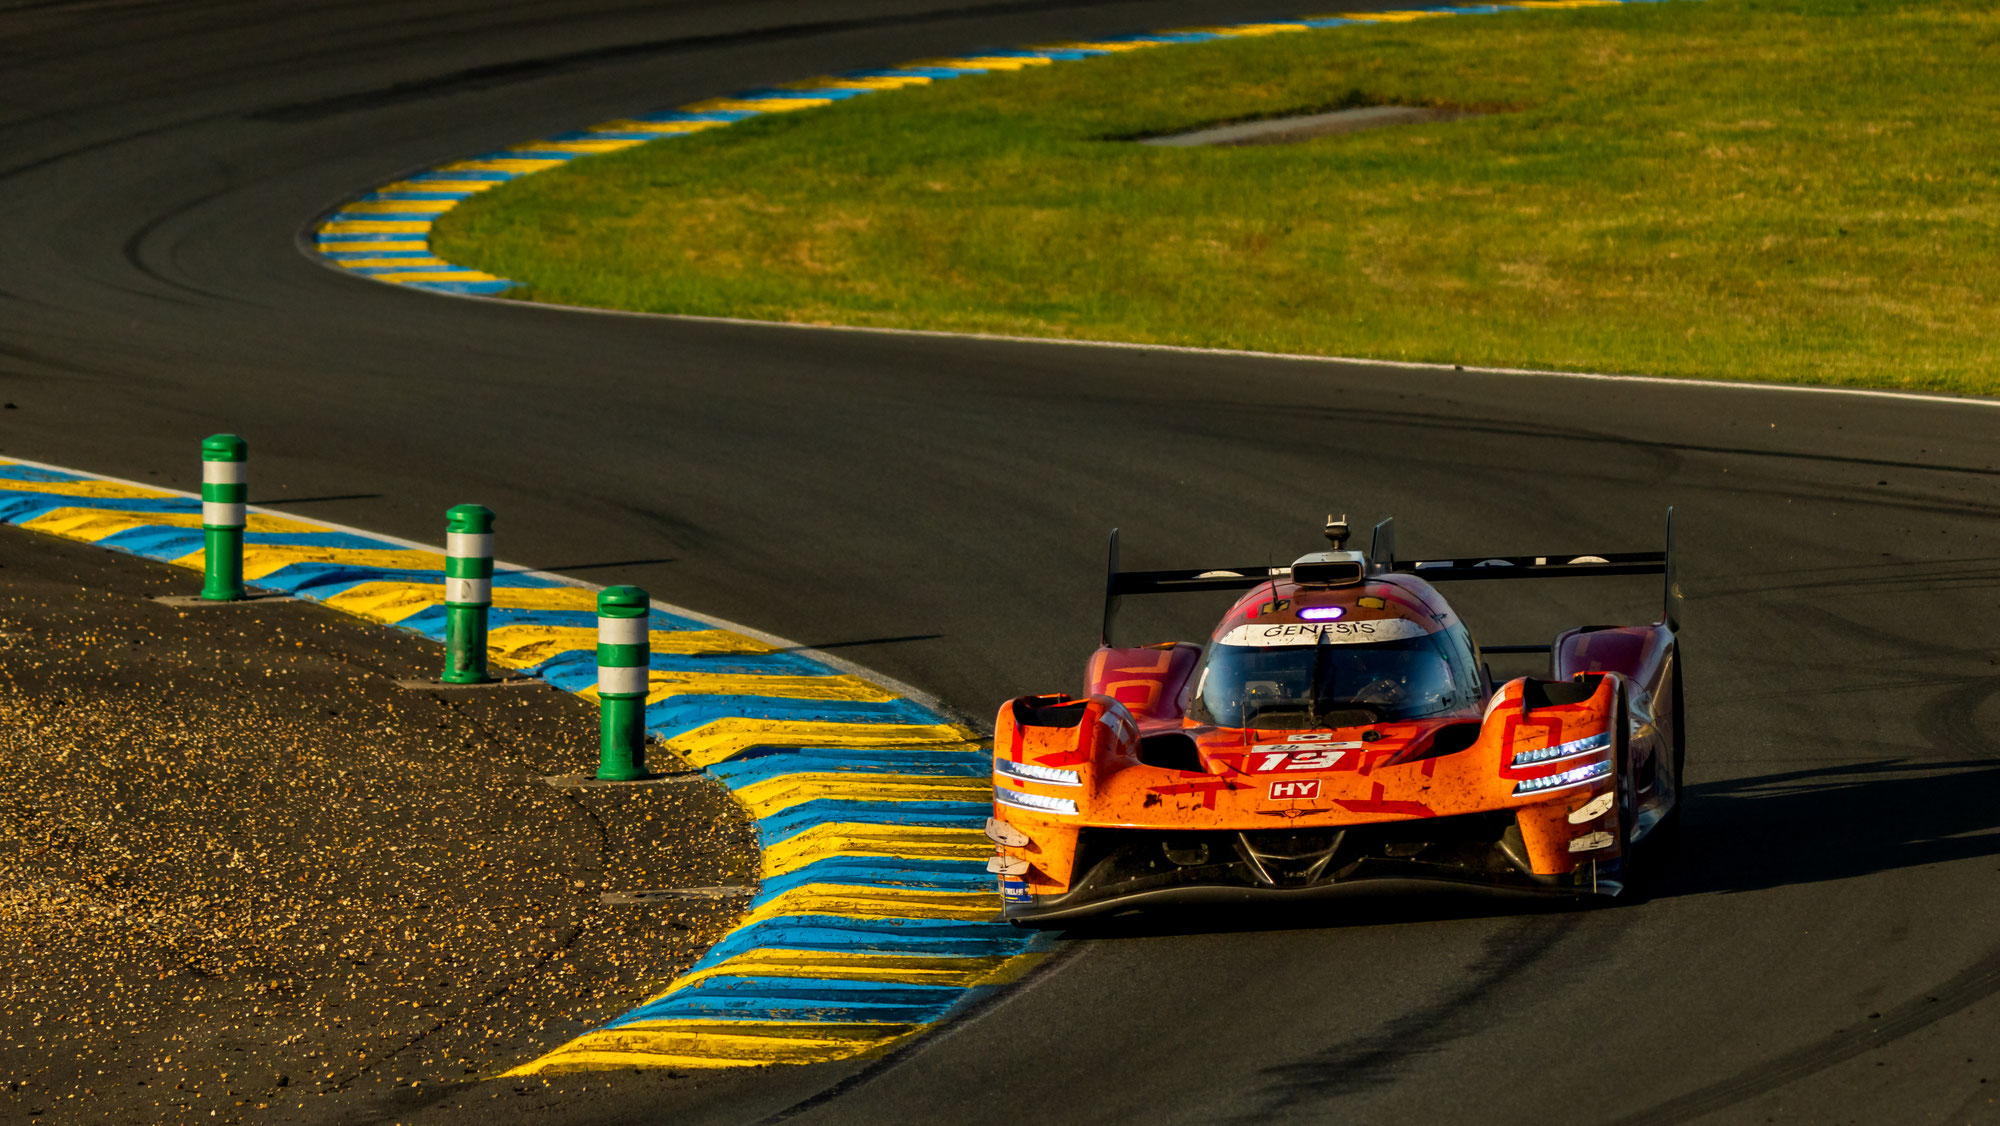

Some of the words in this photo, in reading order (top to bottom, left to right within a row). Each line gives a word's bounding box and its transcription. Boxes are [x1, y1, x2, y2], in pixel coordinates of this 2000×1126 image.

[1264, 622, 1375, 637] GENESIS
[1257, 751, 1346, 771] 19
[1274, 782, 1316, 796] HY
